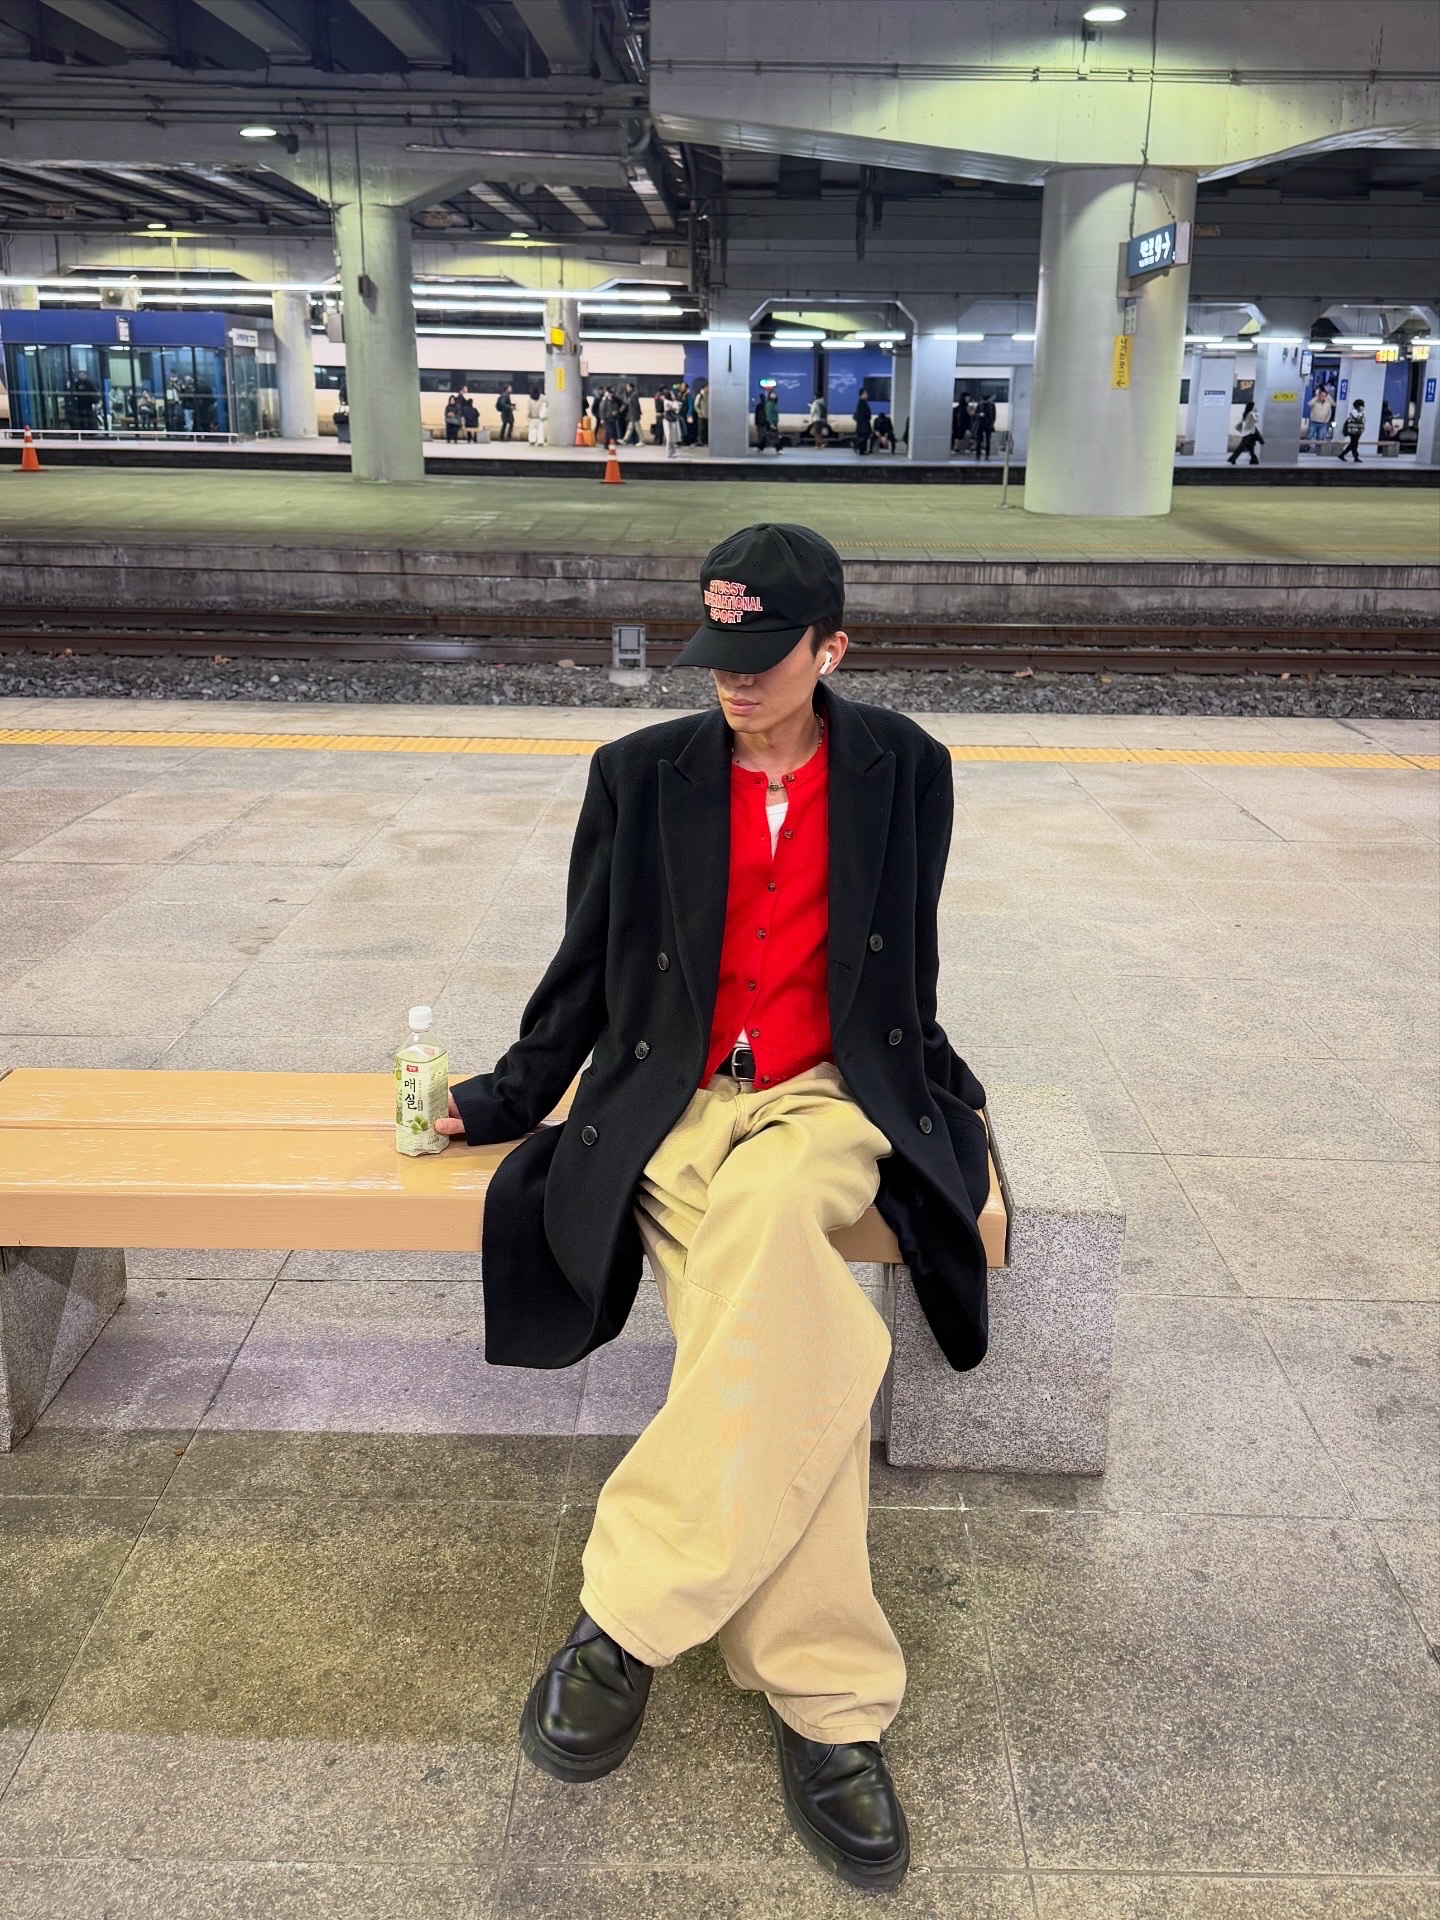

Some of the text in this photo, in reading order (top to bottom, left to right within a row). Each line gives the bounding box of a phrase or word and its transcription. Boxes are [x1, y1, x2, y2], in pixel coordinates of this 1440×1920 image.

[703, 590, 763, 611] TERNATIONAL
[709, 607, 743, 623] SPORT
[404, 1077, 418, 1112] 매실
